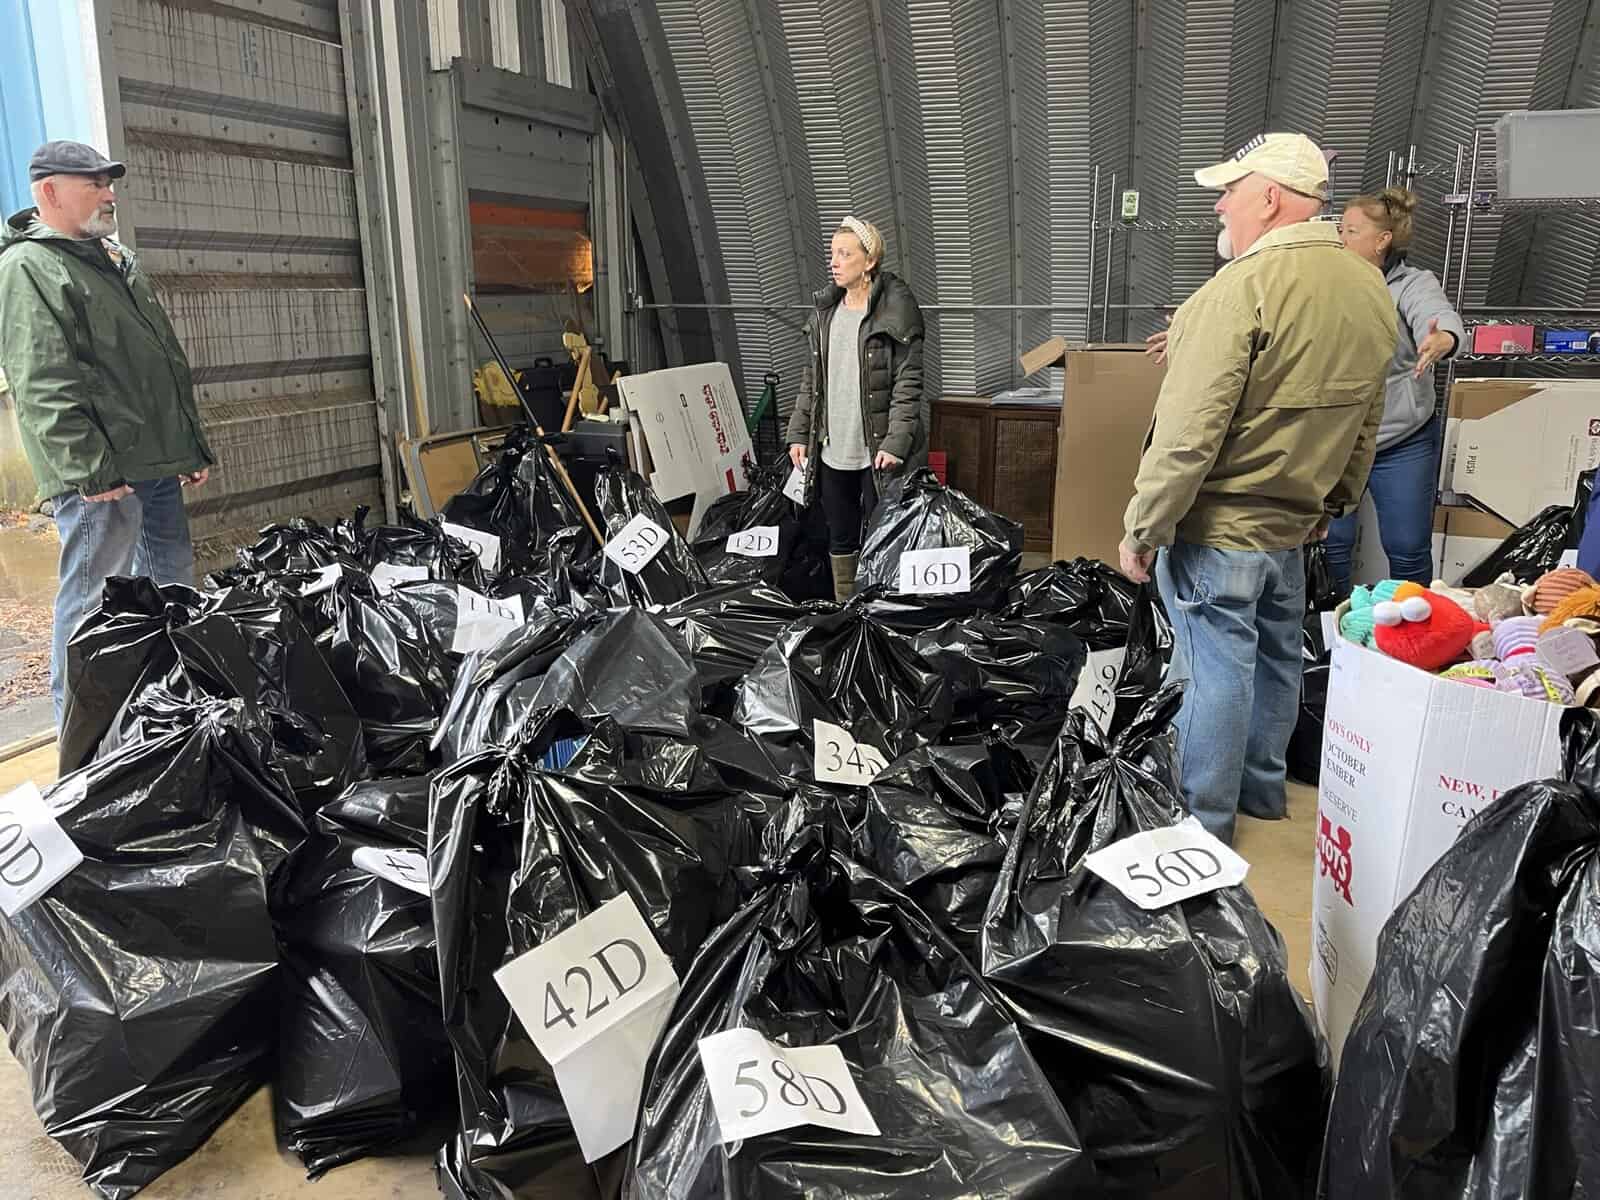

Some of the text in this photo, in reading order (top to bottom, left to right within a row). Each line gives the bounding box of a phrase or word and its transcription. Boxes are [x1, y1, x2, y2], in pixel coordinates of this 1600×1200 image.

[1466, 455, 1478, 474] PUSH
[620, 526, 659, 565] 53D
[735, 534, 772, 551] 12D
[911, 562, 961, 586] 16D
[1346, 730, 1373, 754] ONLY
[1326, 741, 1368, 777] OCTOBER
[1438, 774, 1485, 801] NEW,
[1126, 848, 1222, 897] 56D
[542, 937, 648, 1030] 42D
[734, 1058, 848, 1119] 58D
